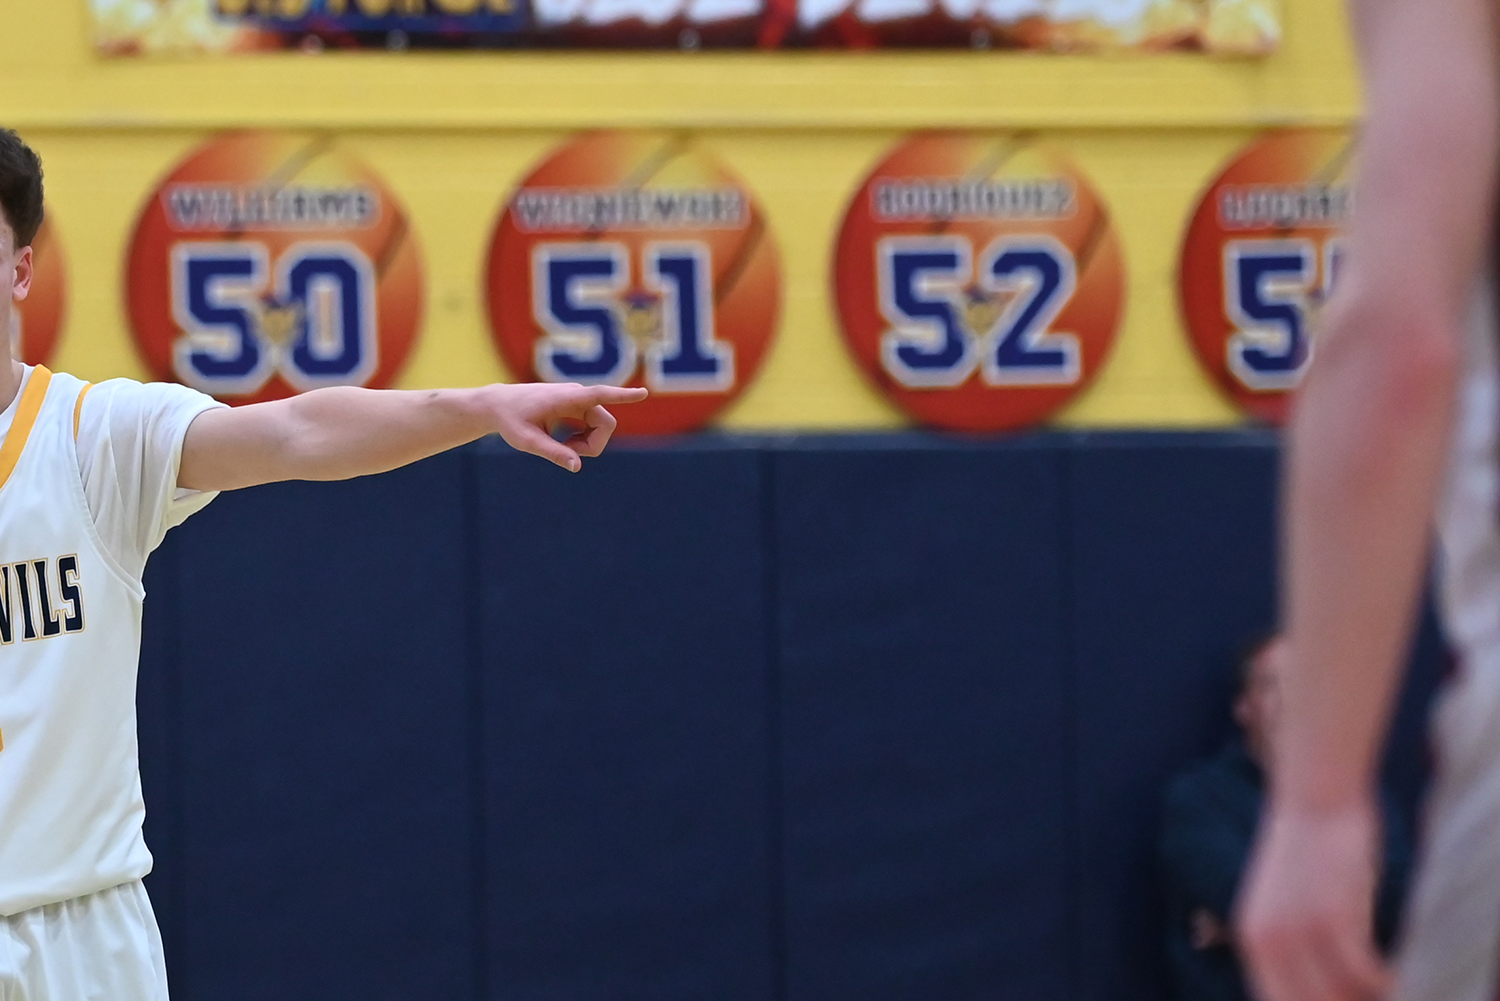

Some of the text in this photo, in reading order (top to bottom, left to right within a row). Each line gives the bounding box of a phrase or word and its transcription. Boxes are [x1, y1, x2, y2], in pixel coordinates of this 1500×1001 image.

[164, 183, 380, 230] WILLIAMS
[170, 240, 378, 394] 50
[533, 240, 734, 394] 51
[876, 234, 1081, 388] 52
[1223, 238, 1343, 390] 5
